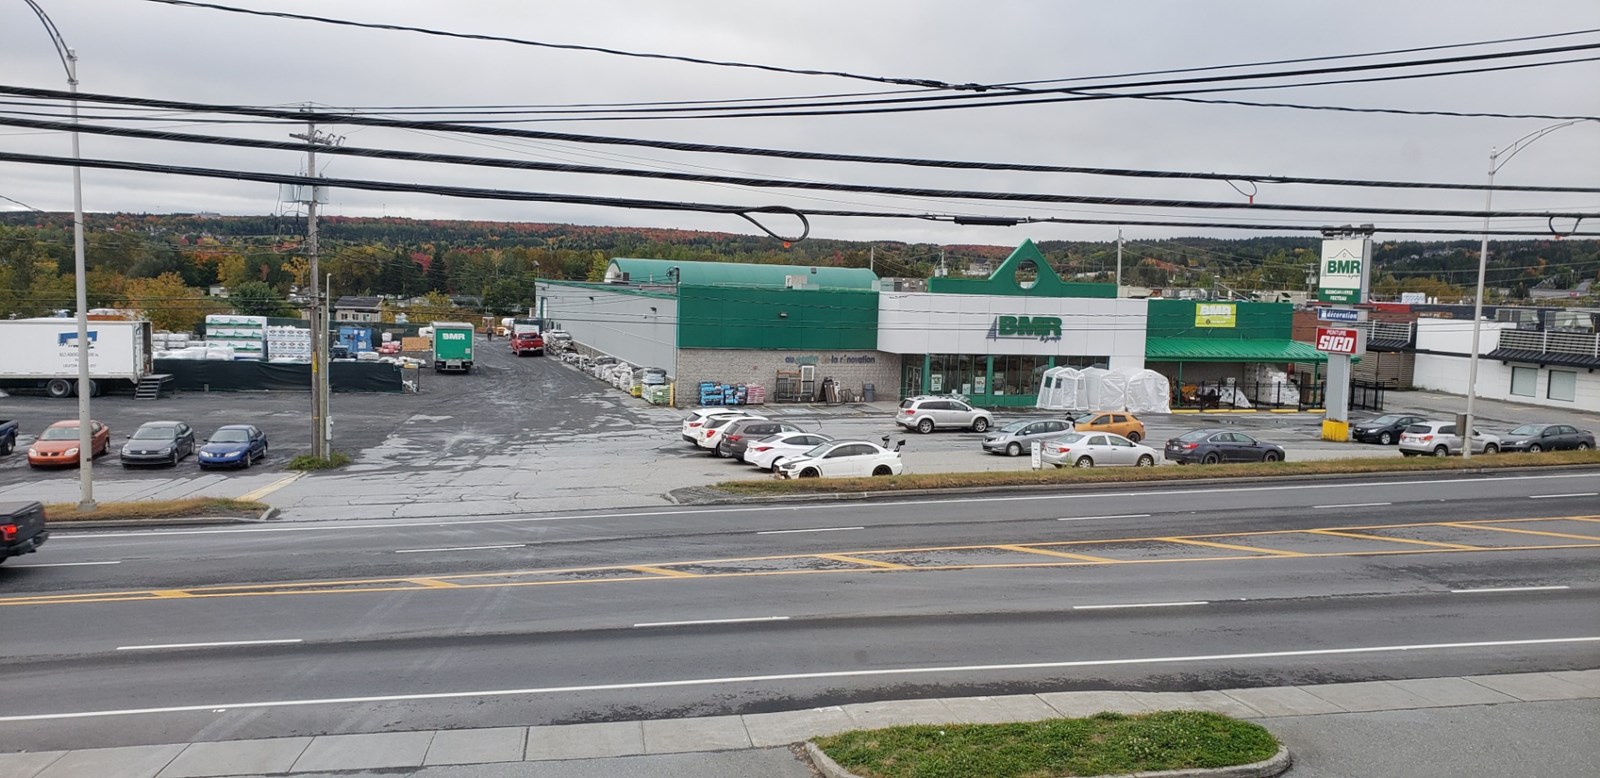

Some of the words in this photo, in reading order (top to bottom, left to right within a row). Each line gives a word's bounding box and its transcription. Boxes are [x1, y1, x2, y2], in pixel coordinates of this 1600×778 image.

[1327, 260, 1361, 274] BMR
[1200, 304, 1232, 316] BMR
[1327, 310, 1357, 319] décoration
[998, 316, 1062, 336] BMR
[442, 332, 466, 340] BMR
[1318, 335, 1355, 352] SICO
[840, 355, 875, 363] rnovation
